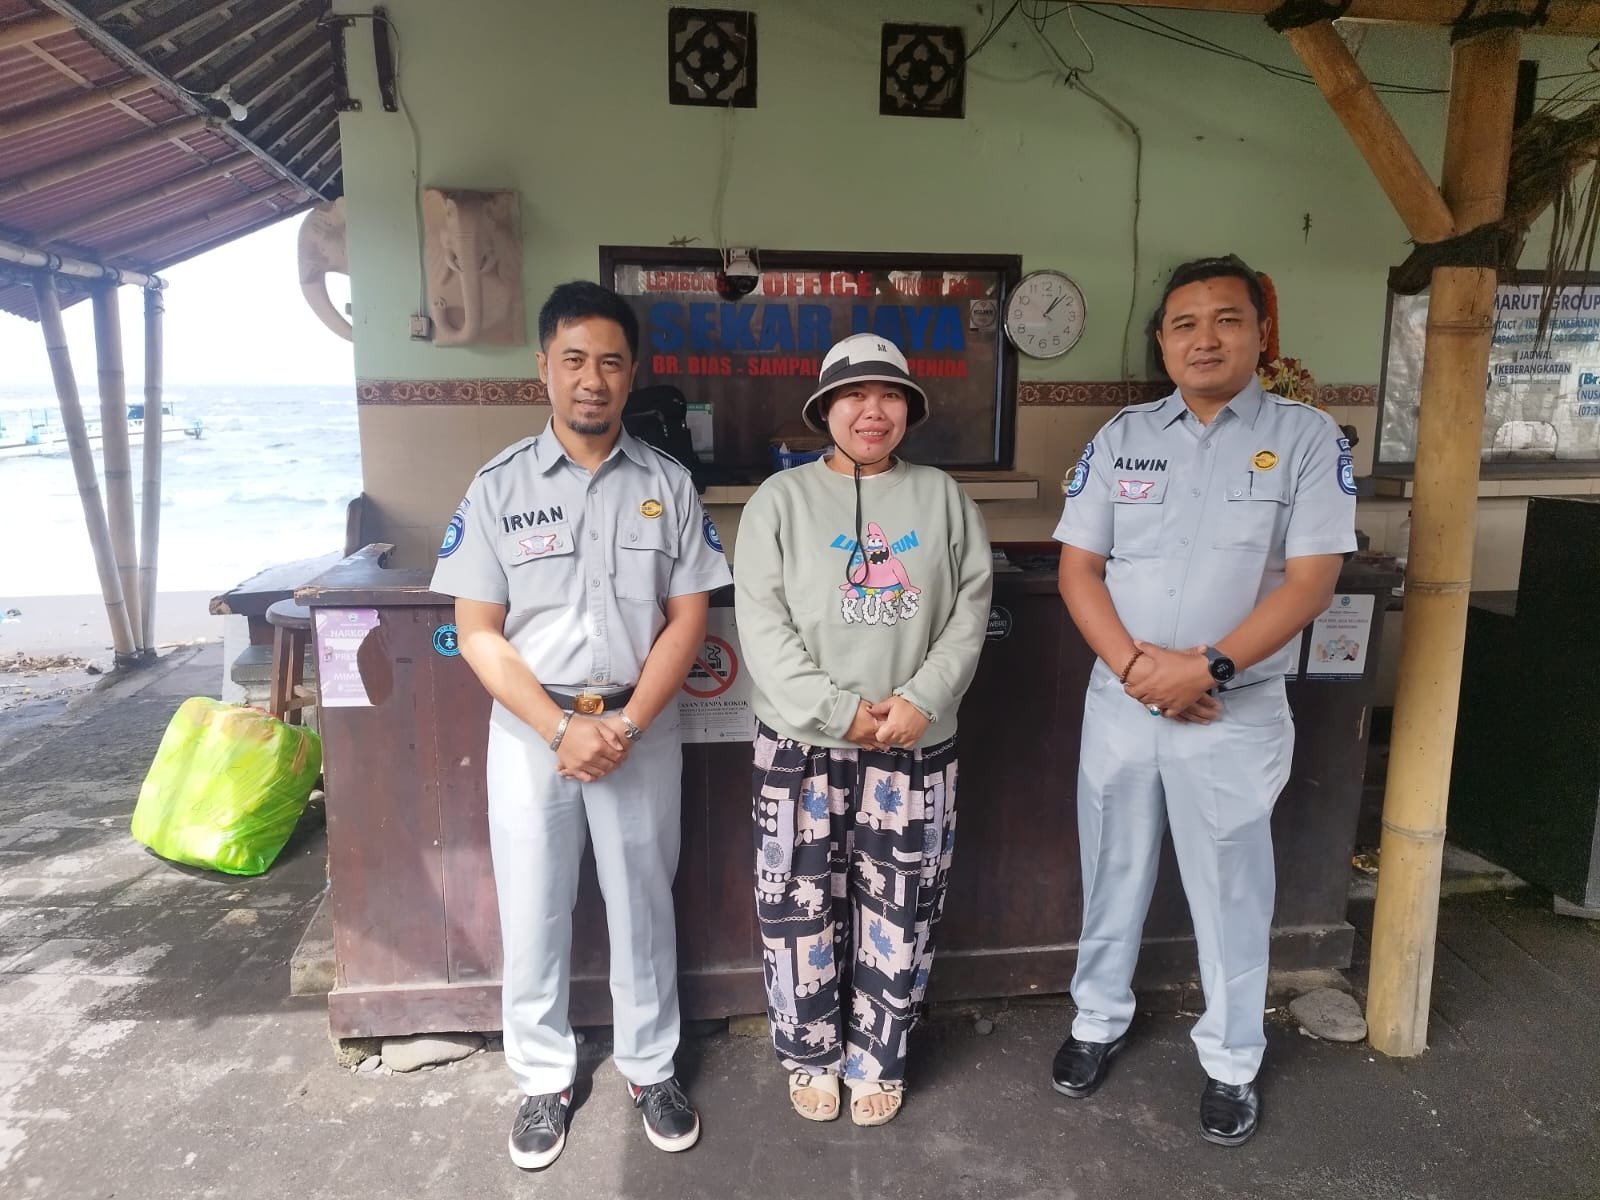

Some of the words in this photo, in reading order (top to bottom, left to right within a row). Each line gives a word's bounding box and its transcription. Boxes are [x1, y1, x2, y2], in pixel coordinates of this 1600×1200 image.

[763, 271, 872, 297] OFFICE
[651, 302, 832, 352] SEKAR
[851, 304, 966, 352] JAYA
[1027, 334, 1035, 344] 7
[1038, 339, 1047, 349] 6
[1520, 350, 1553, 360] JADWAL
[688, 356, 732, 376] BIAS
[747, 356, 820, 377] SAMPAL
[1581, 390, 1600, 400] NUS
[1114, 457, 1168, 472] ALWIN
[502, 505, 563, 533] IRVAN
[891, 530, 919, 554] FUN
